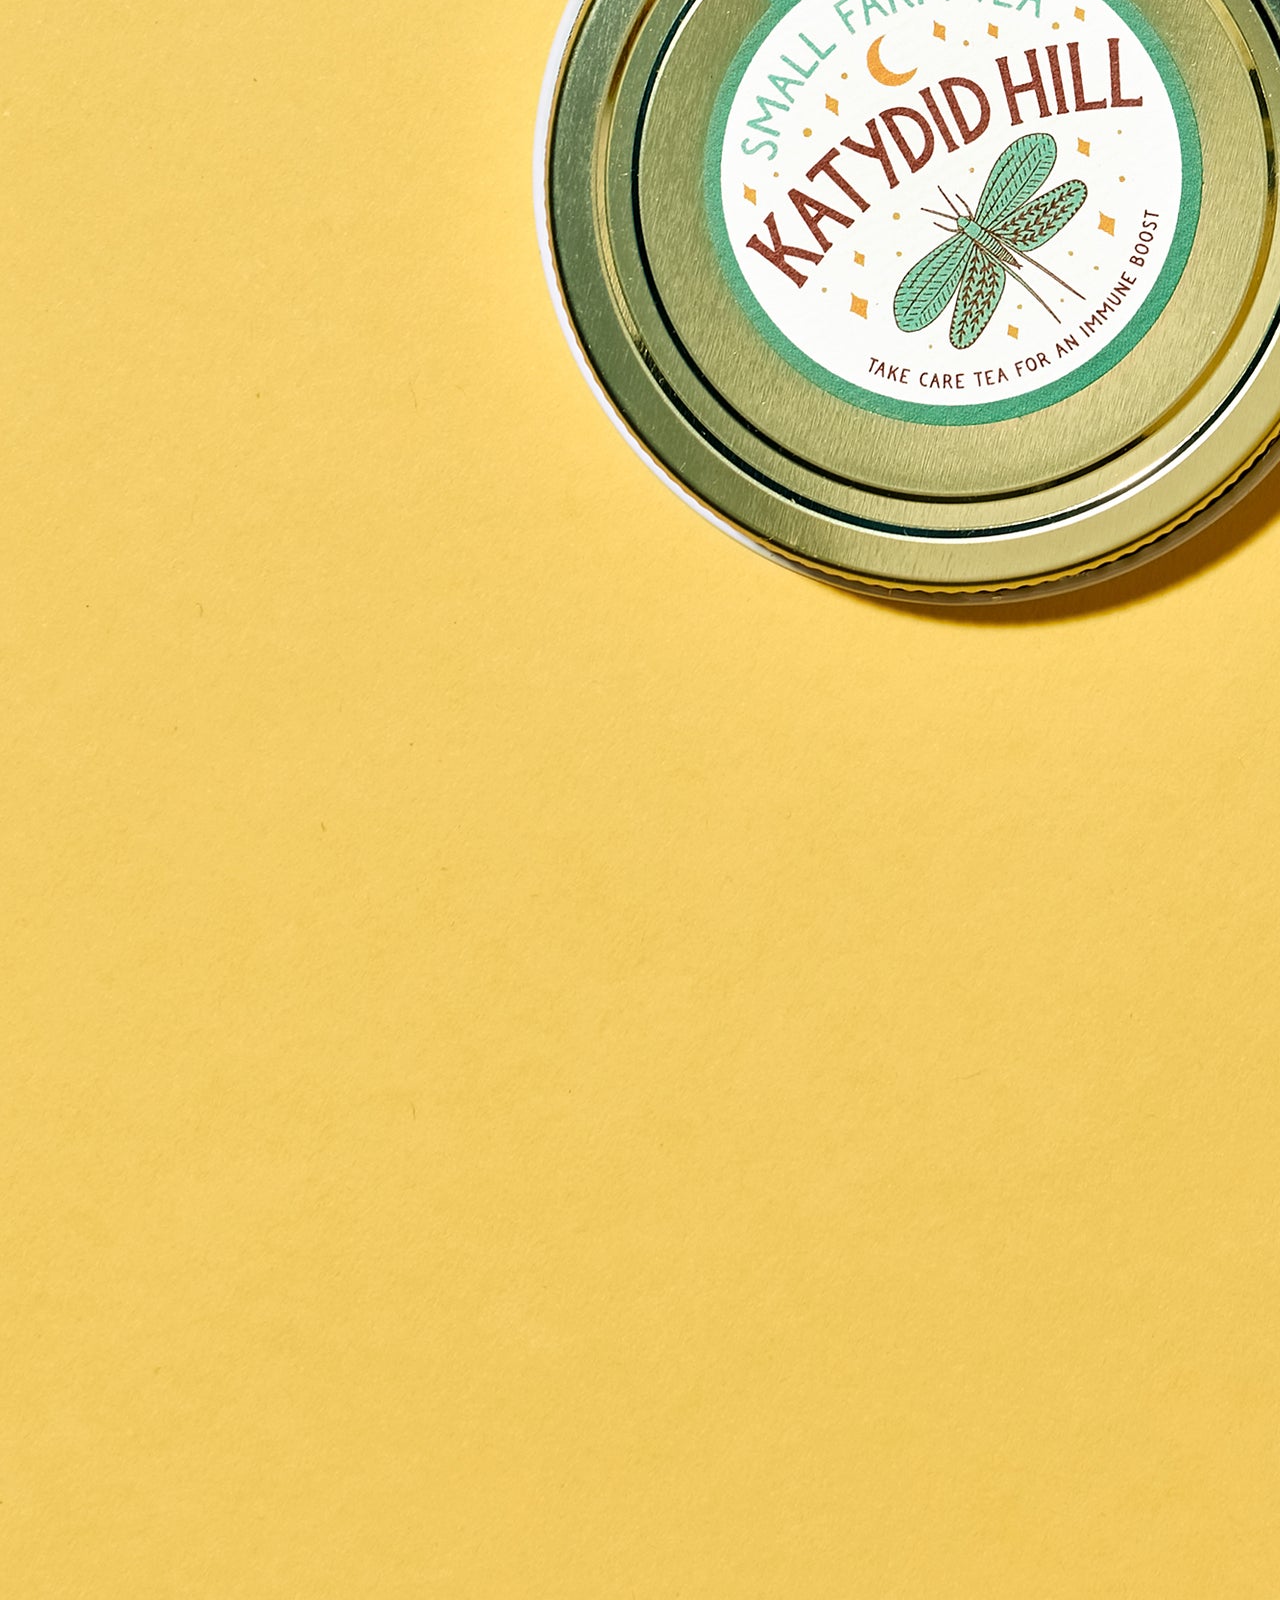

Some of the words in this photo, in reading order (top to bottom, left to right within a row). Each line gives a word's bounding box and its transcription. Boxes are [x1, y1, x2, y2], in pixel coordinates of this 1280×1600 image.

[741, 32, 837, 161] SMALL
[746, 77, 991, 289] KATYDID
[995, 37, 1143, 127] HILL
[868, 357, 911, 385] TAKE
[919, 372, 965, 390] CARE
[973, 367, 1009, 388] TEA
[1014, 352, 1051, 377] FOR
[1055, 334, 1080, 359] AN
[1079, 271, 1137, 338] IMMUNE
[1129, 209, 1160, 268] BOOST
